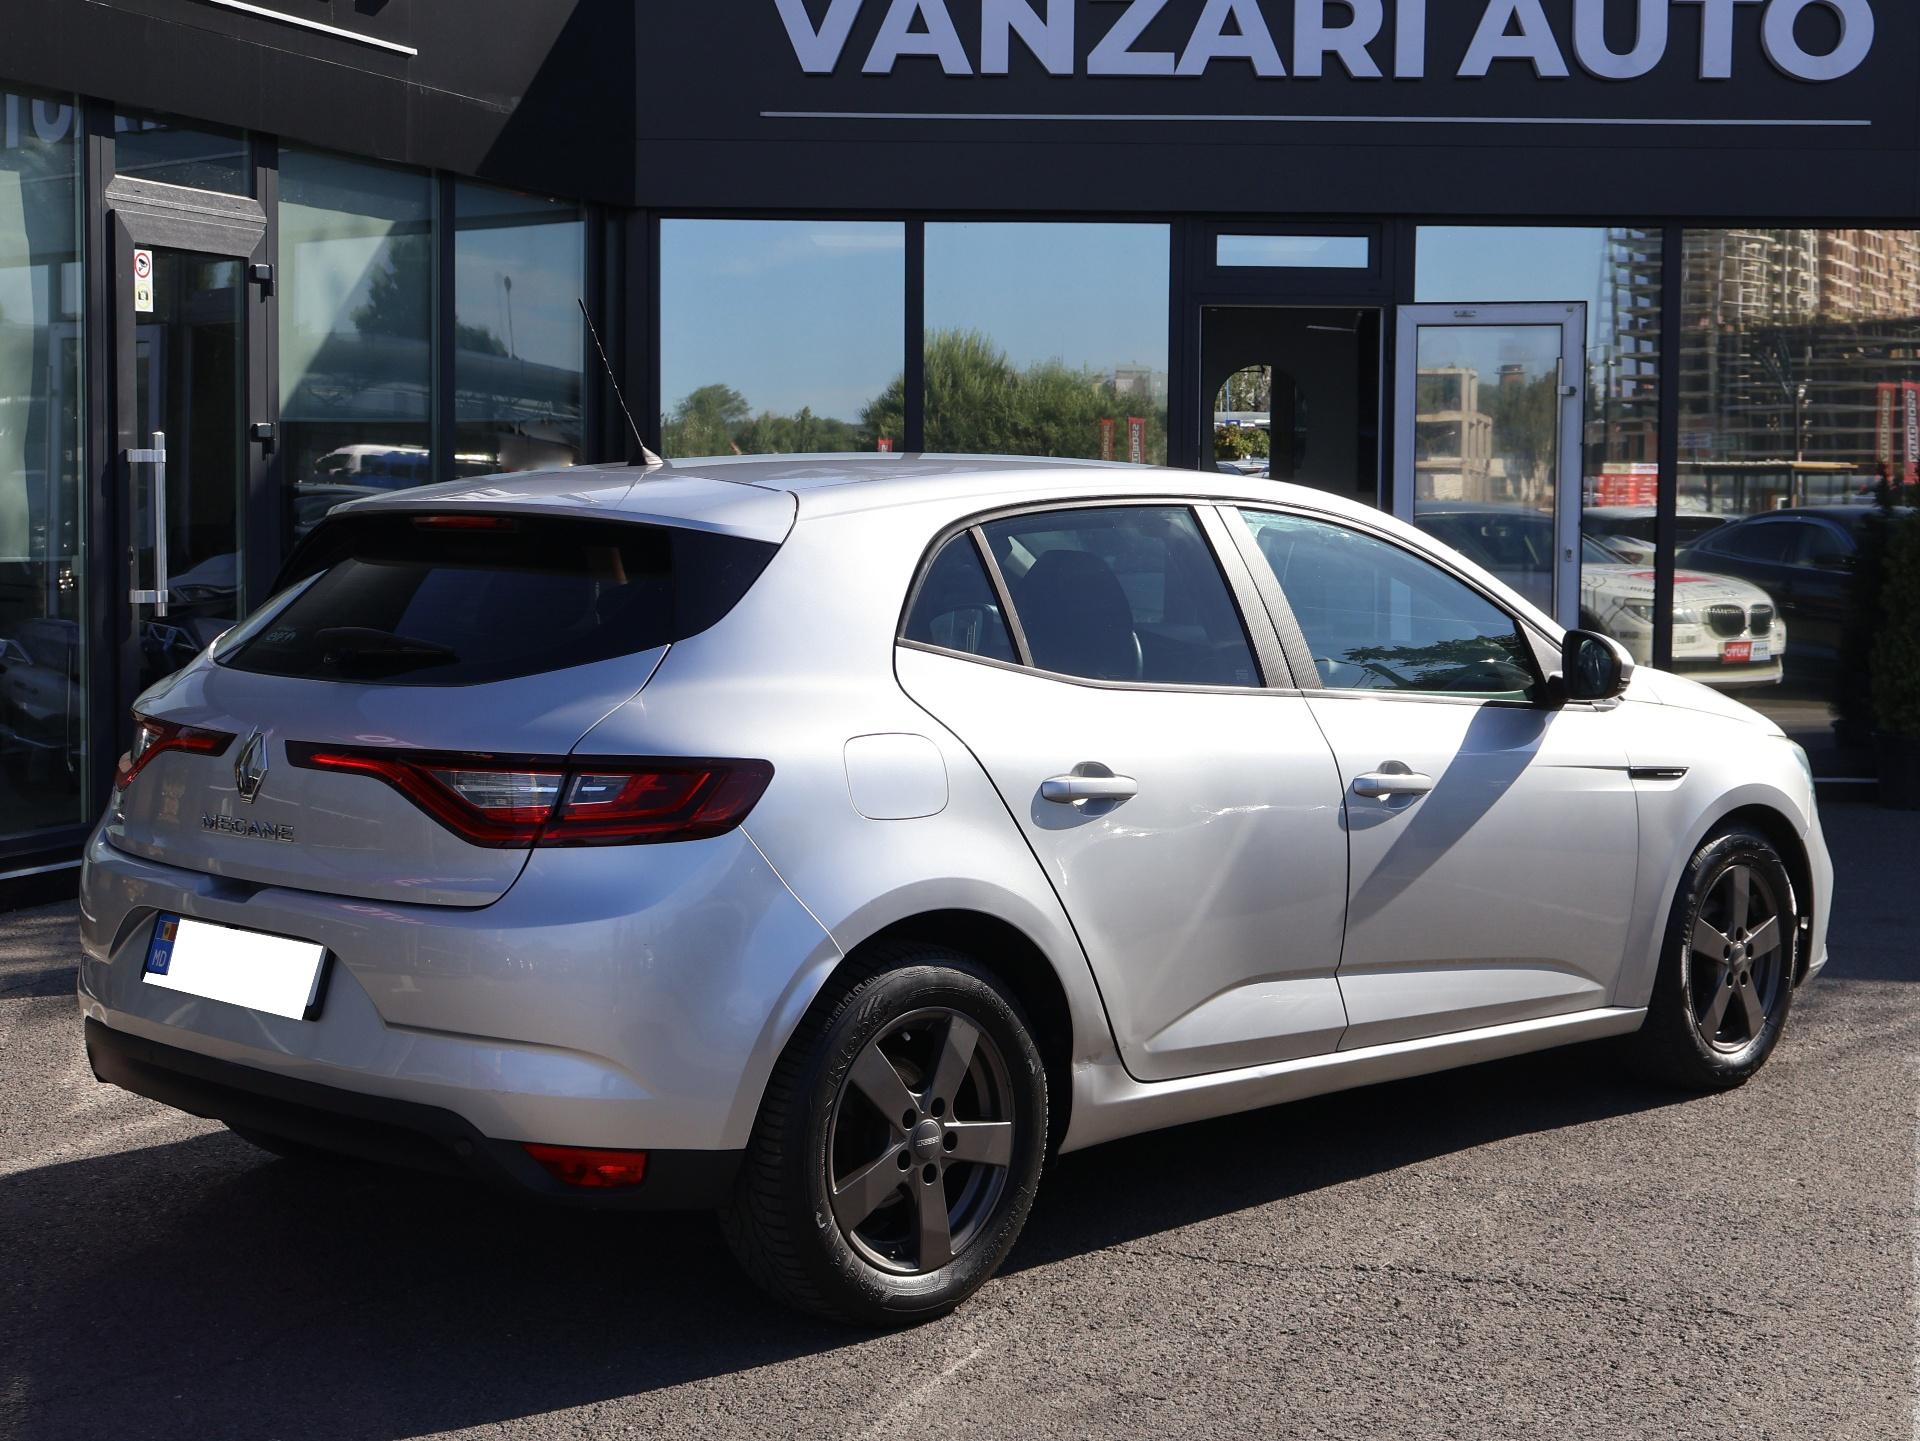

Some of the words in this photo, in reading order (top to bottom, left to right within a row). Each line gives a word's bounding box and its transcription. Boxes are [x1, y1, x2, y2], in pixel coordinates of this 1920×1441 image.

[774, 0, 1426, 79] VANZARI
[1455, 0, 1876, 82] AUTO
[200, 811, 295, 842] MEGANE
[152, 949, 167, 967] MD
